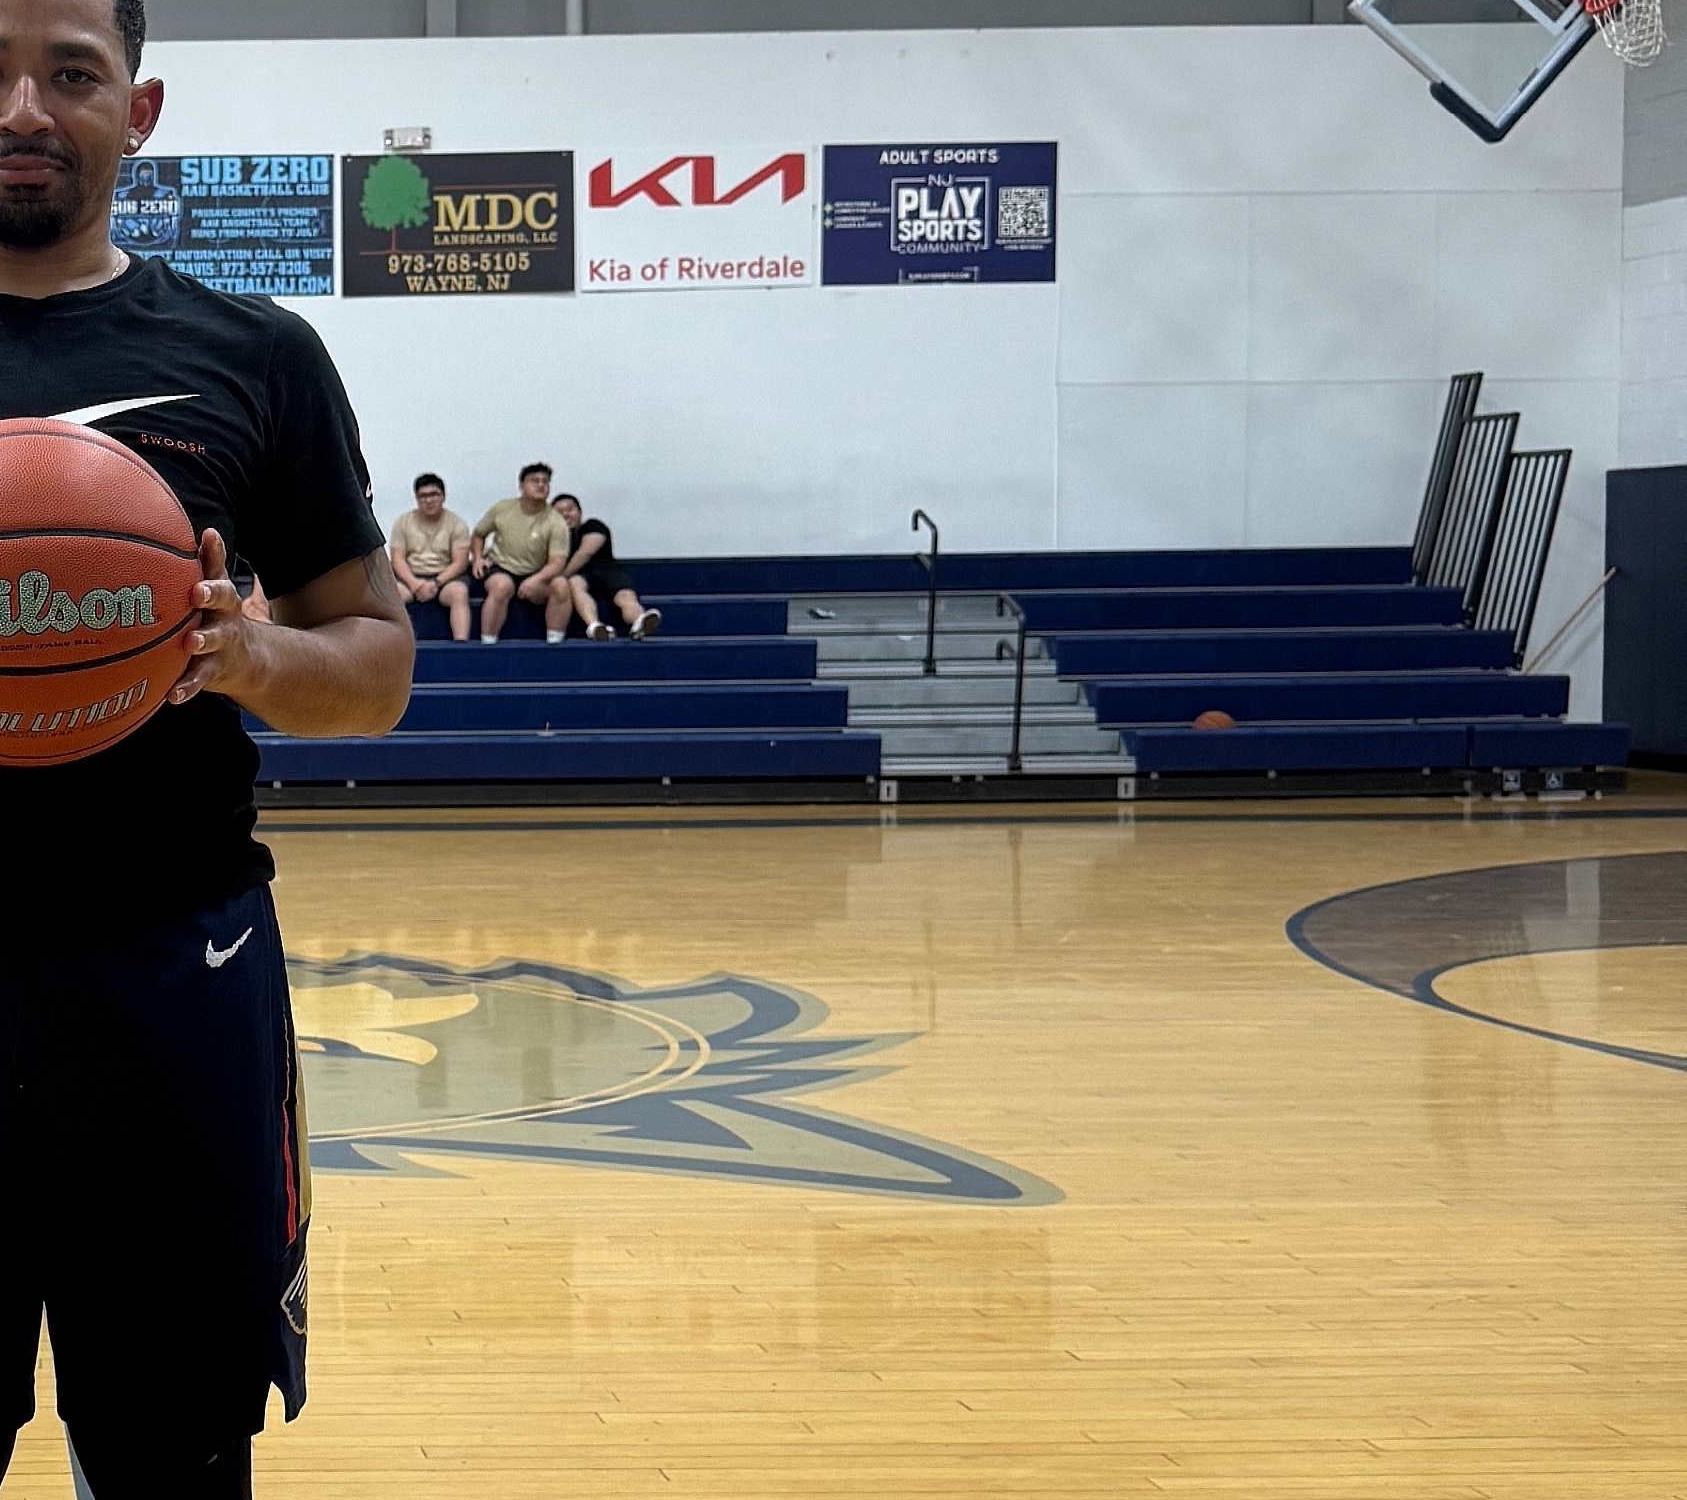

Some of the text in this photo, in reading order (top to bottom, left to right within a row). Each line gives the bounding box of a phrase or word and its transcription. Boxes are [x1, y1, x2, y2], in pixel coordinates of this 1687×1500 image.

[879, 148, 1000, 165] ADULT SPORTS
[180, 156, 330, 185] SUB ZERO
[589, 153, 805, 208] KIA
[927, 174, 954, 187] NJ
[181, 183, 330, 197] AAU BASKETBALL CLUB
[140, 199, 178, 215] ZERO
[432, 191, 558, 232] MDC
[898, 187, 981, 220] PLAY
[433, 232, 558, 246] LANDSCAPING, LLC
[898, 220, 981, 242] SPORTS
[174, 249, 253, 260] INFORMATION
[254, 249, 282, 260] CALL
[897, 242, 981, 255] COMMUNITY
[388, 252, 531, 275] 973-768-5105
[589, 253, 805, 282] Kia of Riverdale
[406, 273, 511, 292] WAYNE, NJ
[141, 433, 205, 455] SWOOSH
